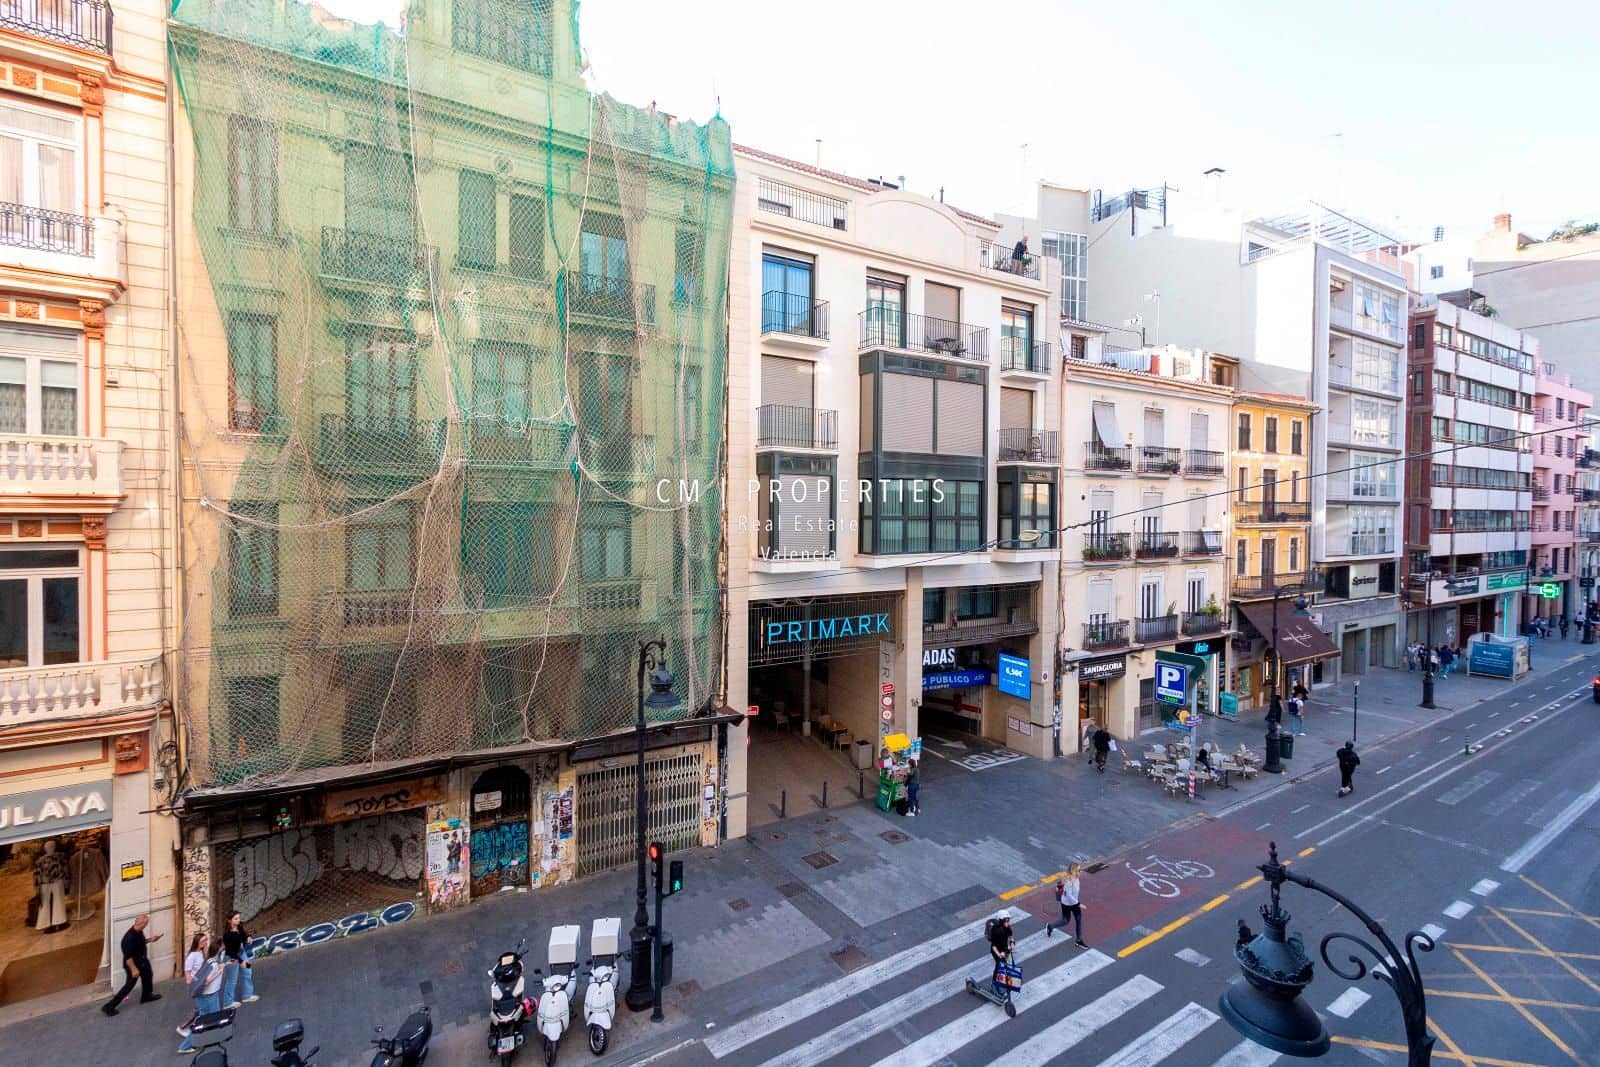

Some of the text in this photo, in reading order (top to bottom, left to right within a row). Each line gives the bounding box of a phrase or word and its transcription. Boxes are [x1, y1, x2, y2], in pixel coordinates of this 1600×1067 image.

[767, 613, 889, 645] PRIMARK
[922, 648, 955, 666] ADAS
[1161, 666, 1180, 688] P
